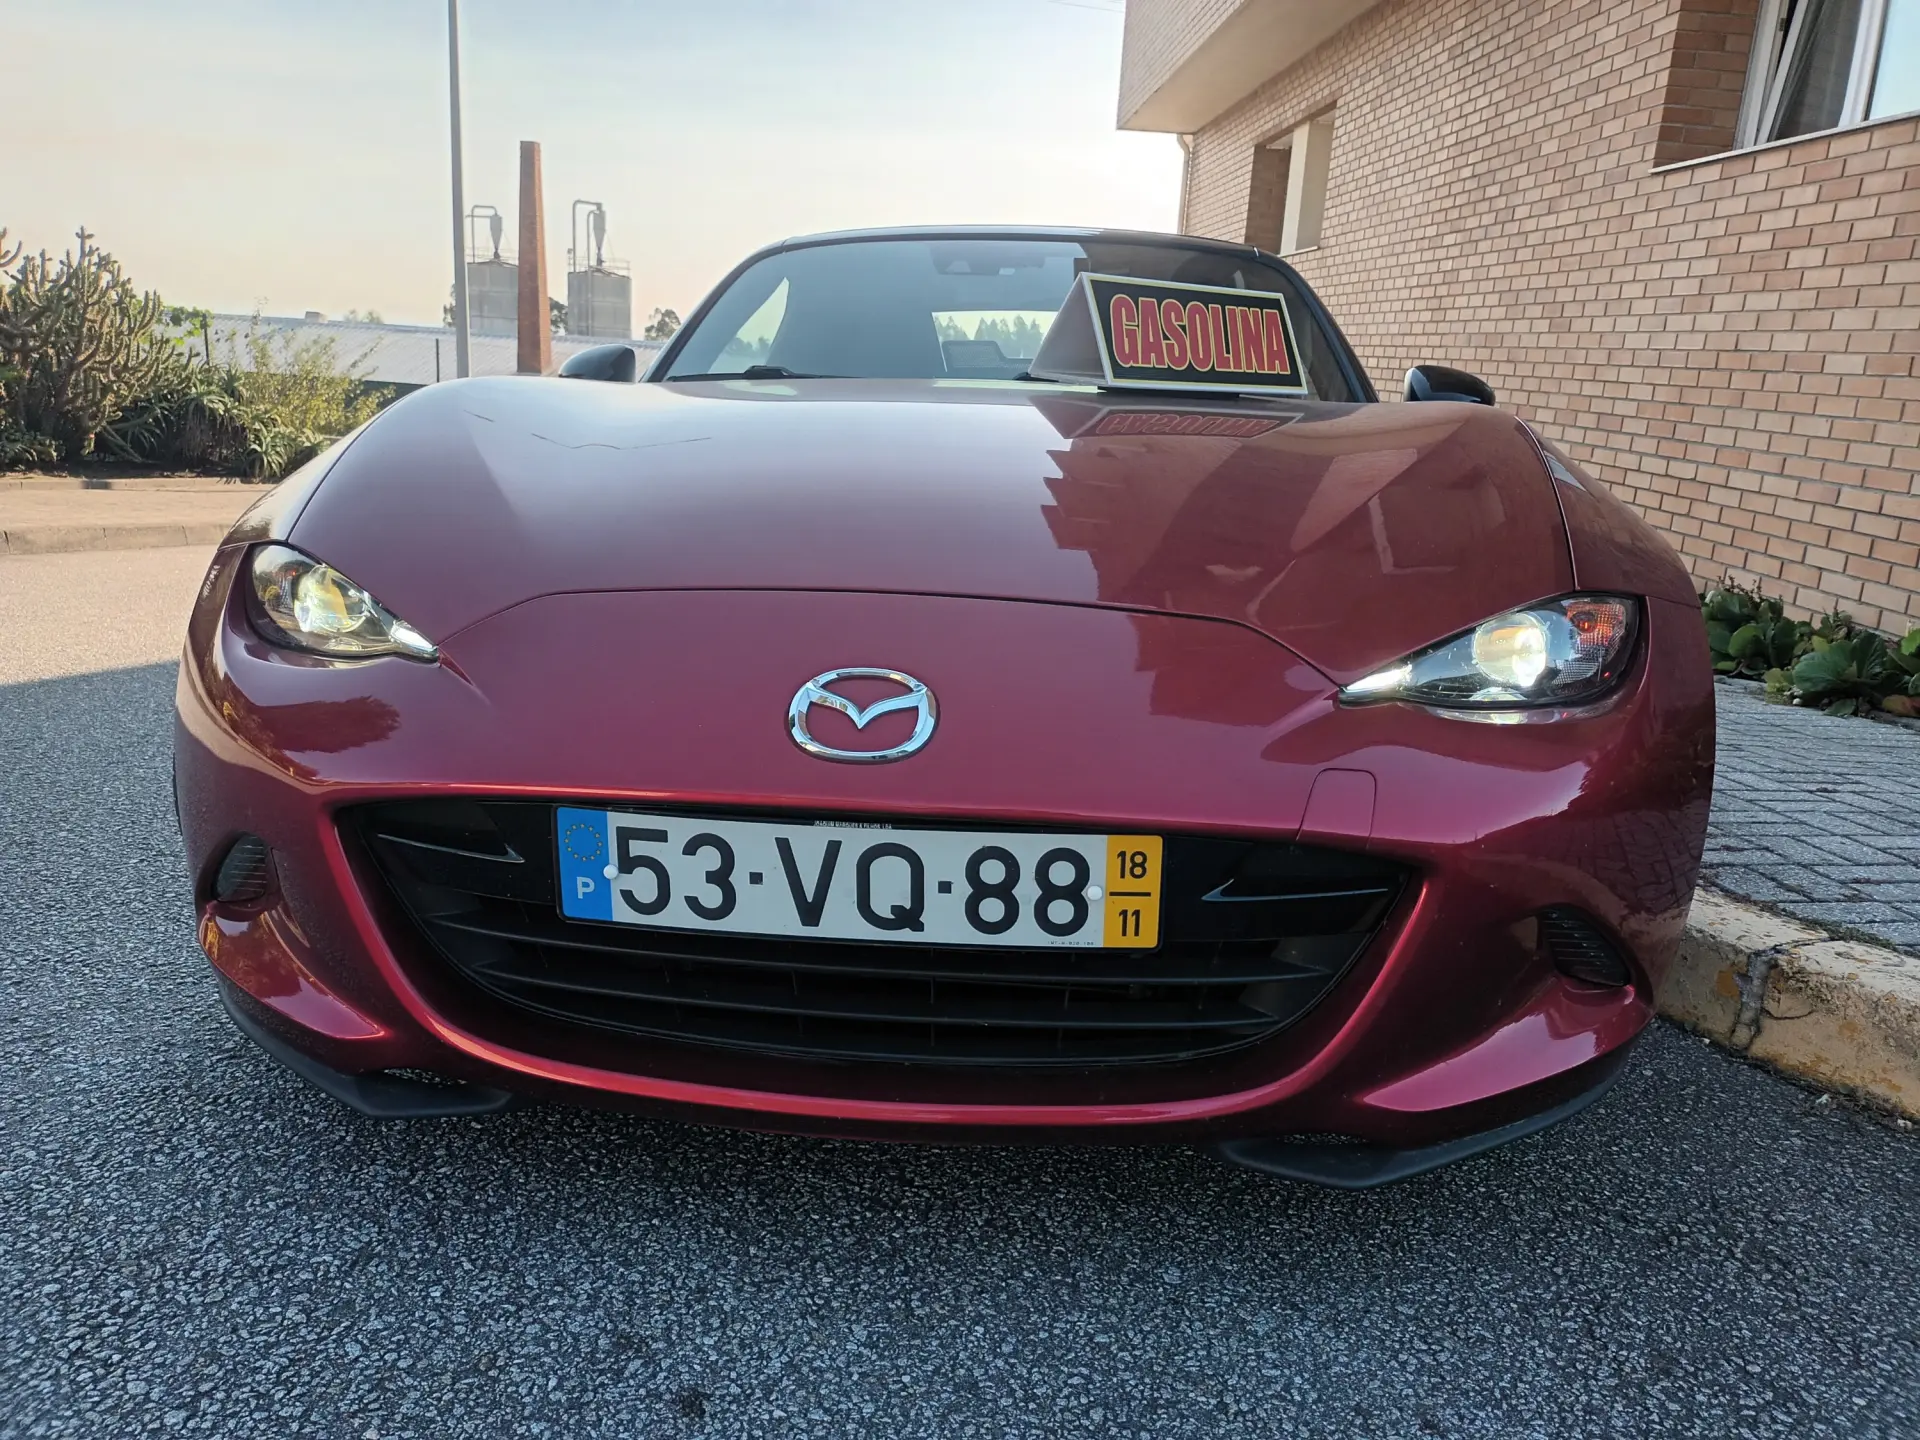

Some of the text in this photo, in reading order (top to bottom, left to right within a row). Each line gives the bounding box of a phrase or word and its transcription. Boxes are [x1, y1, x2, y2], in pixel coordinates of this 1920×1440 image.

[1110, 294, 1291, 375] GASOLINA
[1116, 850, 1148, 880] 18
[576, 876, 596, 900] P
[1118, 909, 1141, 937] 11
